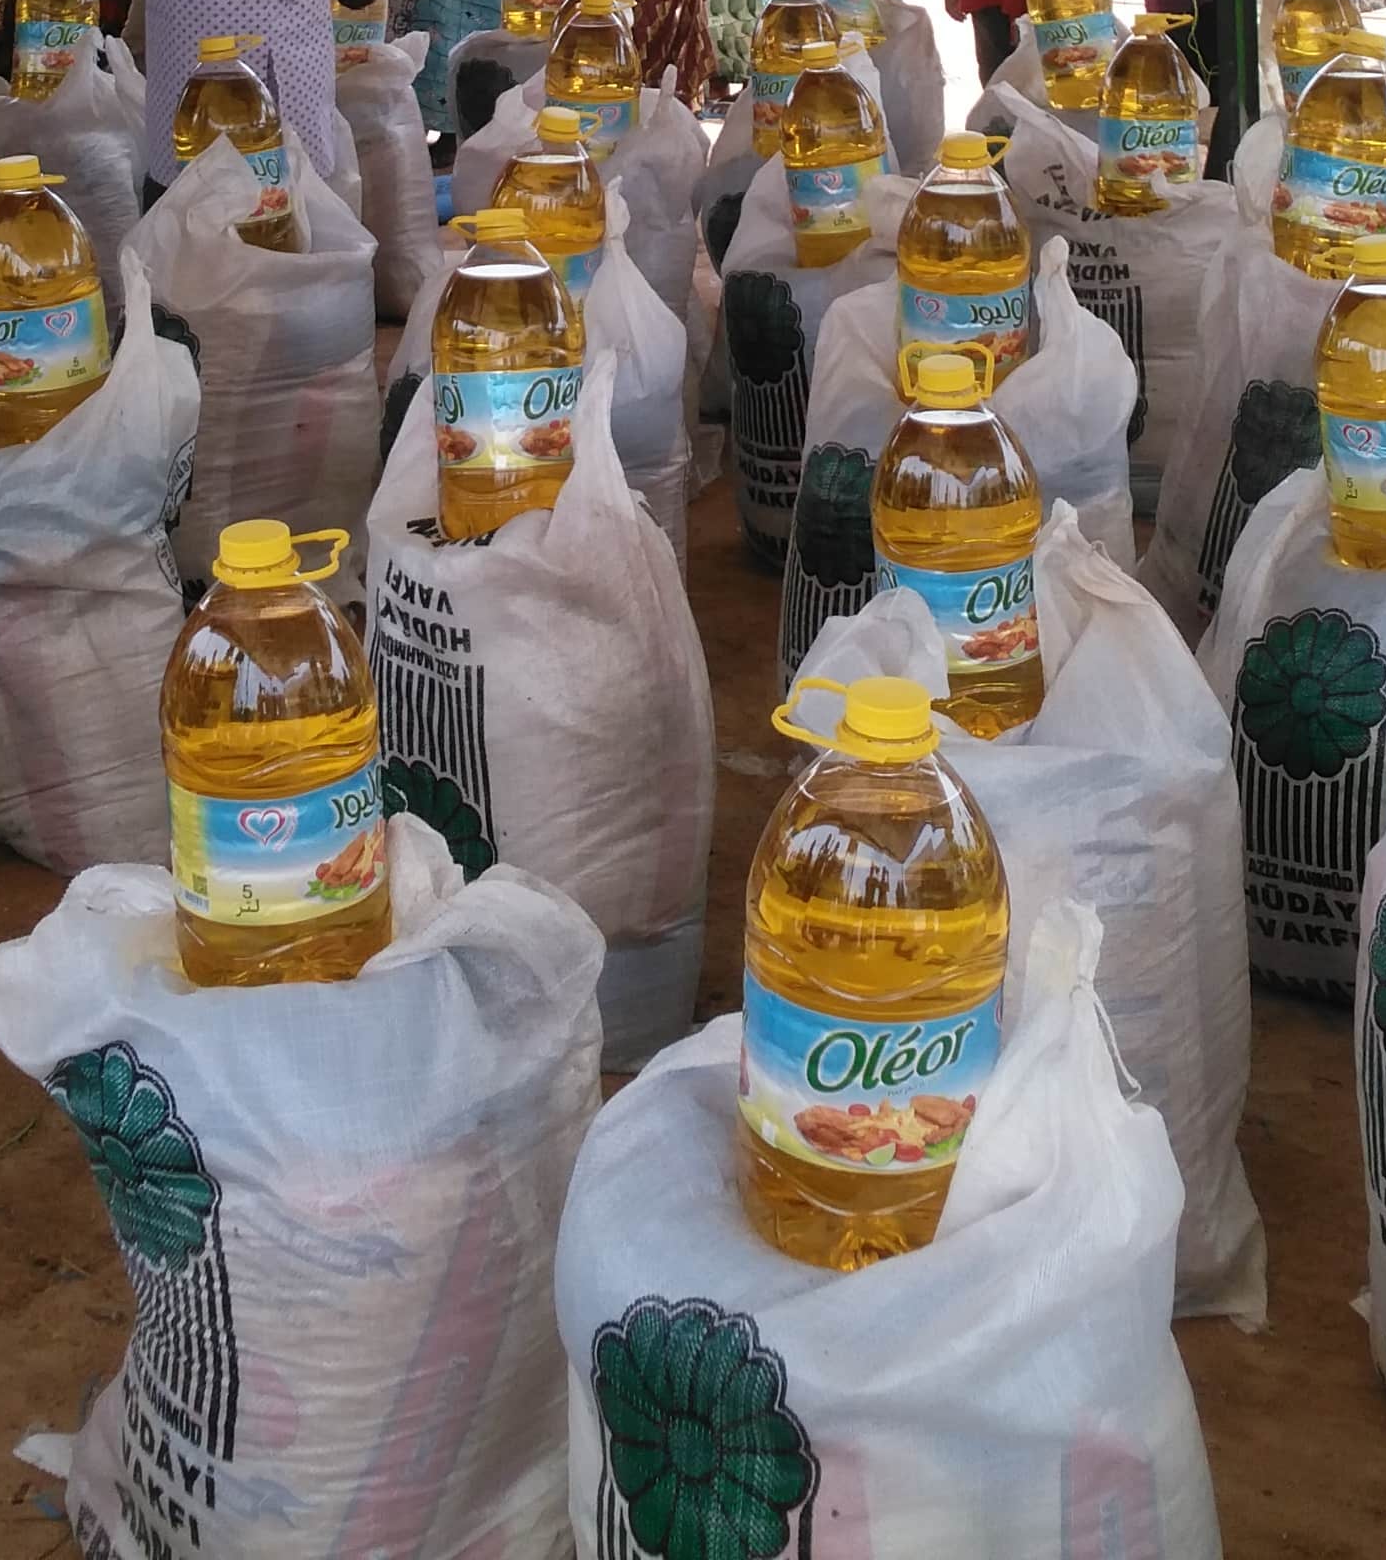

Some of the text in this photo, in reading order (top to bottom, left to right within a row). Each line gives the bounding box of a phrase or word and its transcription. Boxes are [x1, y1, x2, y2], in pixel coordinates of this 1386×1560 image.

[1121, 124, 1186, 151] Oléor
[385, 558, 454, 616] VAKFI
[380, 596, 472, 654] HÜDÂY
[235, 898, 261, 918] لتر
[241, 884, 253, 899] 5
[805, 1015, 977, 1095] Oléor
[121, 1425, 201, 1550] VAKFI
